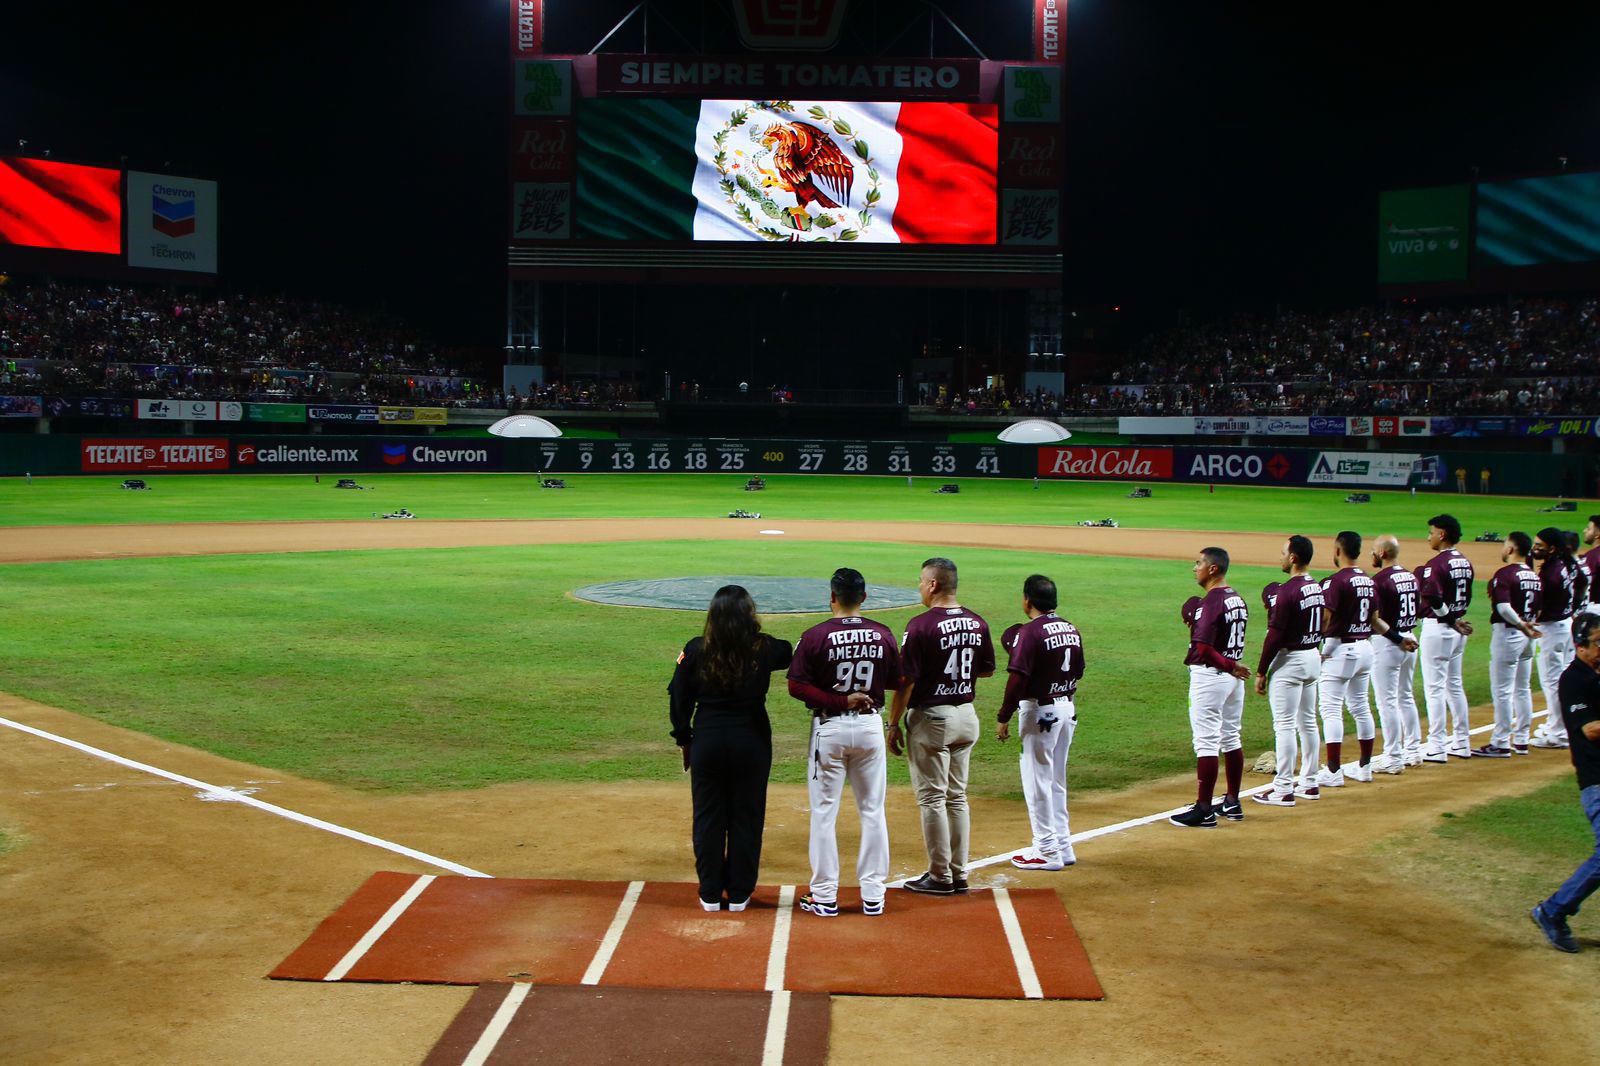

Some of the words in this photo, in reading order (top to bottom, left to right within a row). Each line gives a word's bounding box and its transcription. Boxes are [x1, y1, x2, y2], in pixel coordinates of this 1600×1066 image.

[1043, 8, 1058, 60] TECATE
[620, 62, 765, 86] SIEMPRE
[776, 63, 960, 90] TOMATERO
[517, 127, 567, 154] Red
[1008, 135, 1056, 160] Red
[529, 154, 561, 170] Cola
[1018, 159, 1051, 176] Cola
[152, 183, 196, 199] Chevron
[524, 189, 568, 203] MUCHO
[151, 246, 196, 261] TECHRON
[85, 445, 145, 463] TECATE
[160, 445, 216, 463] TECATE
[257, 445, 359, 462] caliente.mx
[412, 446, 487, 463] Chevron
[543, 452, 555, 469] 7
[581, 452, 592, 469] 9
[611, 452, 635, 469] 13
[647, 452, 671, 470] 16
[684, 452, 708, 470] 18
[720, 453, 744, 470] 25
[762, 451, 784, 462] 400
[799, 453, 824, 470] 27
[1051, 448, 1098, 474] Red
[1100, 450, 1152, 475] Cola
[843, 454, 868, 471] 28
[888, 455, 911, 472] 31
[931, 455, 956, 472] 33
[975, 456, 1000, 473] 41
[1189, 454, 1262, 478] ARCO
[1360, 598, 1370, 622] 8
[1400, 593, 1416, 617] 36
[937, 617, 973, 635] TECATE
[1309, 607, 1320, 633] 11
[828, 629, 874, 645] TECATE
[940, 632, 982, 650] CAMPOS
[828, 645, 884, 661] AMEZAGA
[1061, 648, 1071, 672] 1
[943, 647, 975, 680] 48
[832, 660, 874, 692] 99
[934, 682, 957, 696] Red
